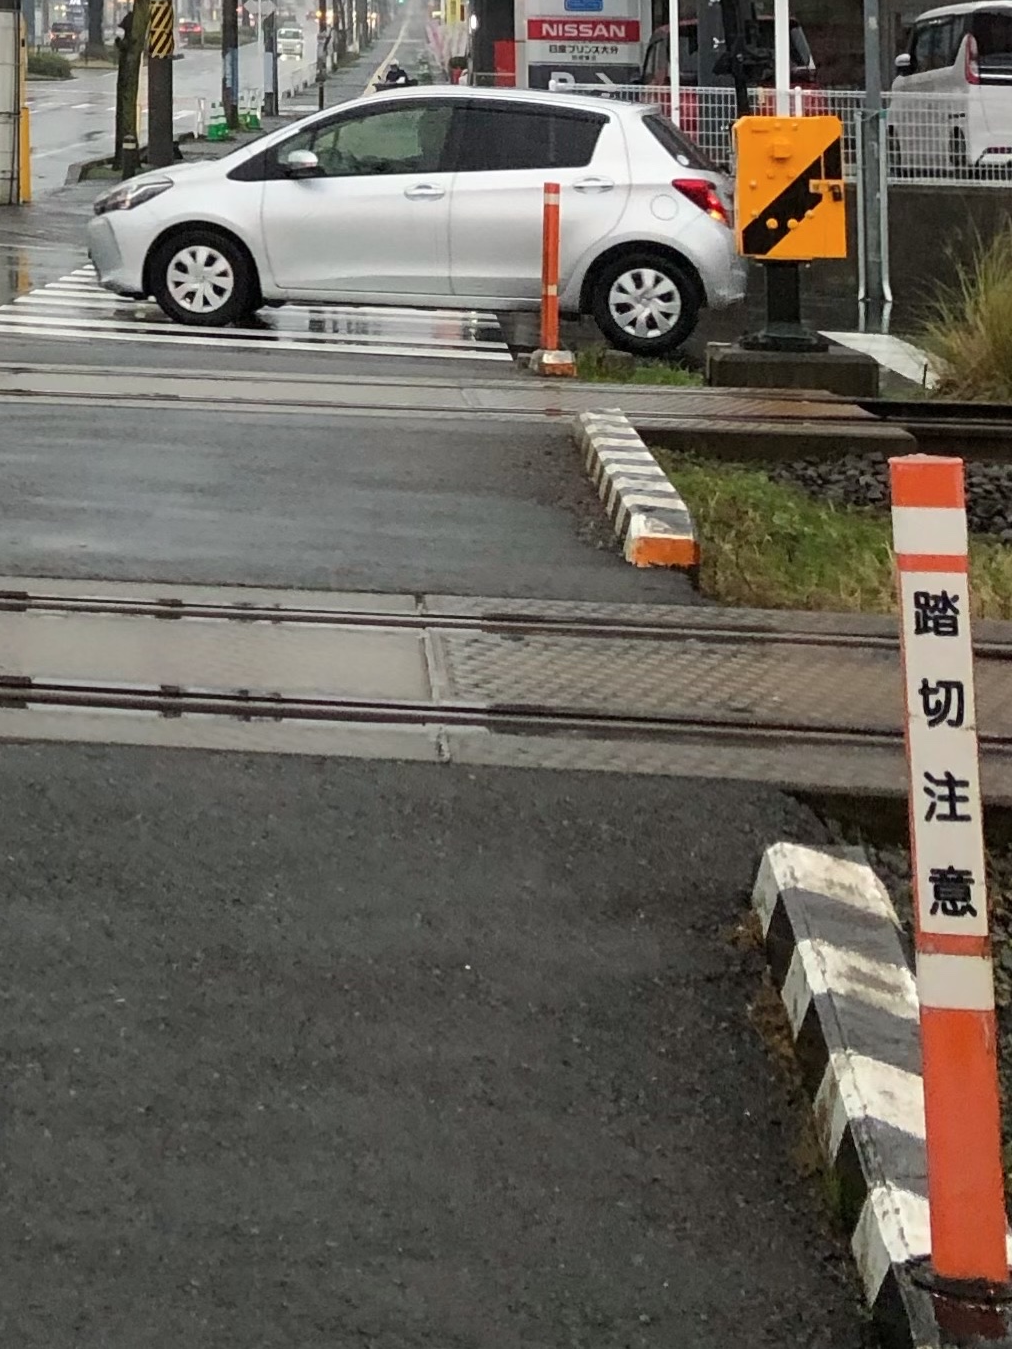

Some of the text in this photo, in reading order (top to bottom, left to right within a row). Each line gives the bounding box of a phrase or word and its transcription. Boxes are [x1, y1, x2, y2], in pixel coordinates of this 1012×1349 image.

[541, 23, 626, 38] NISSAN
[912, 590, 978, 919] 踏切注意
